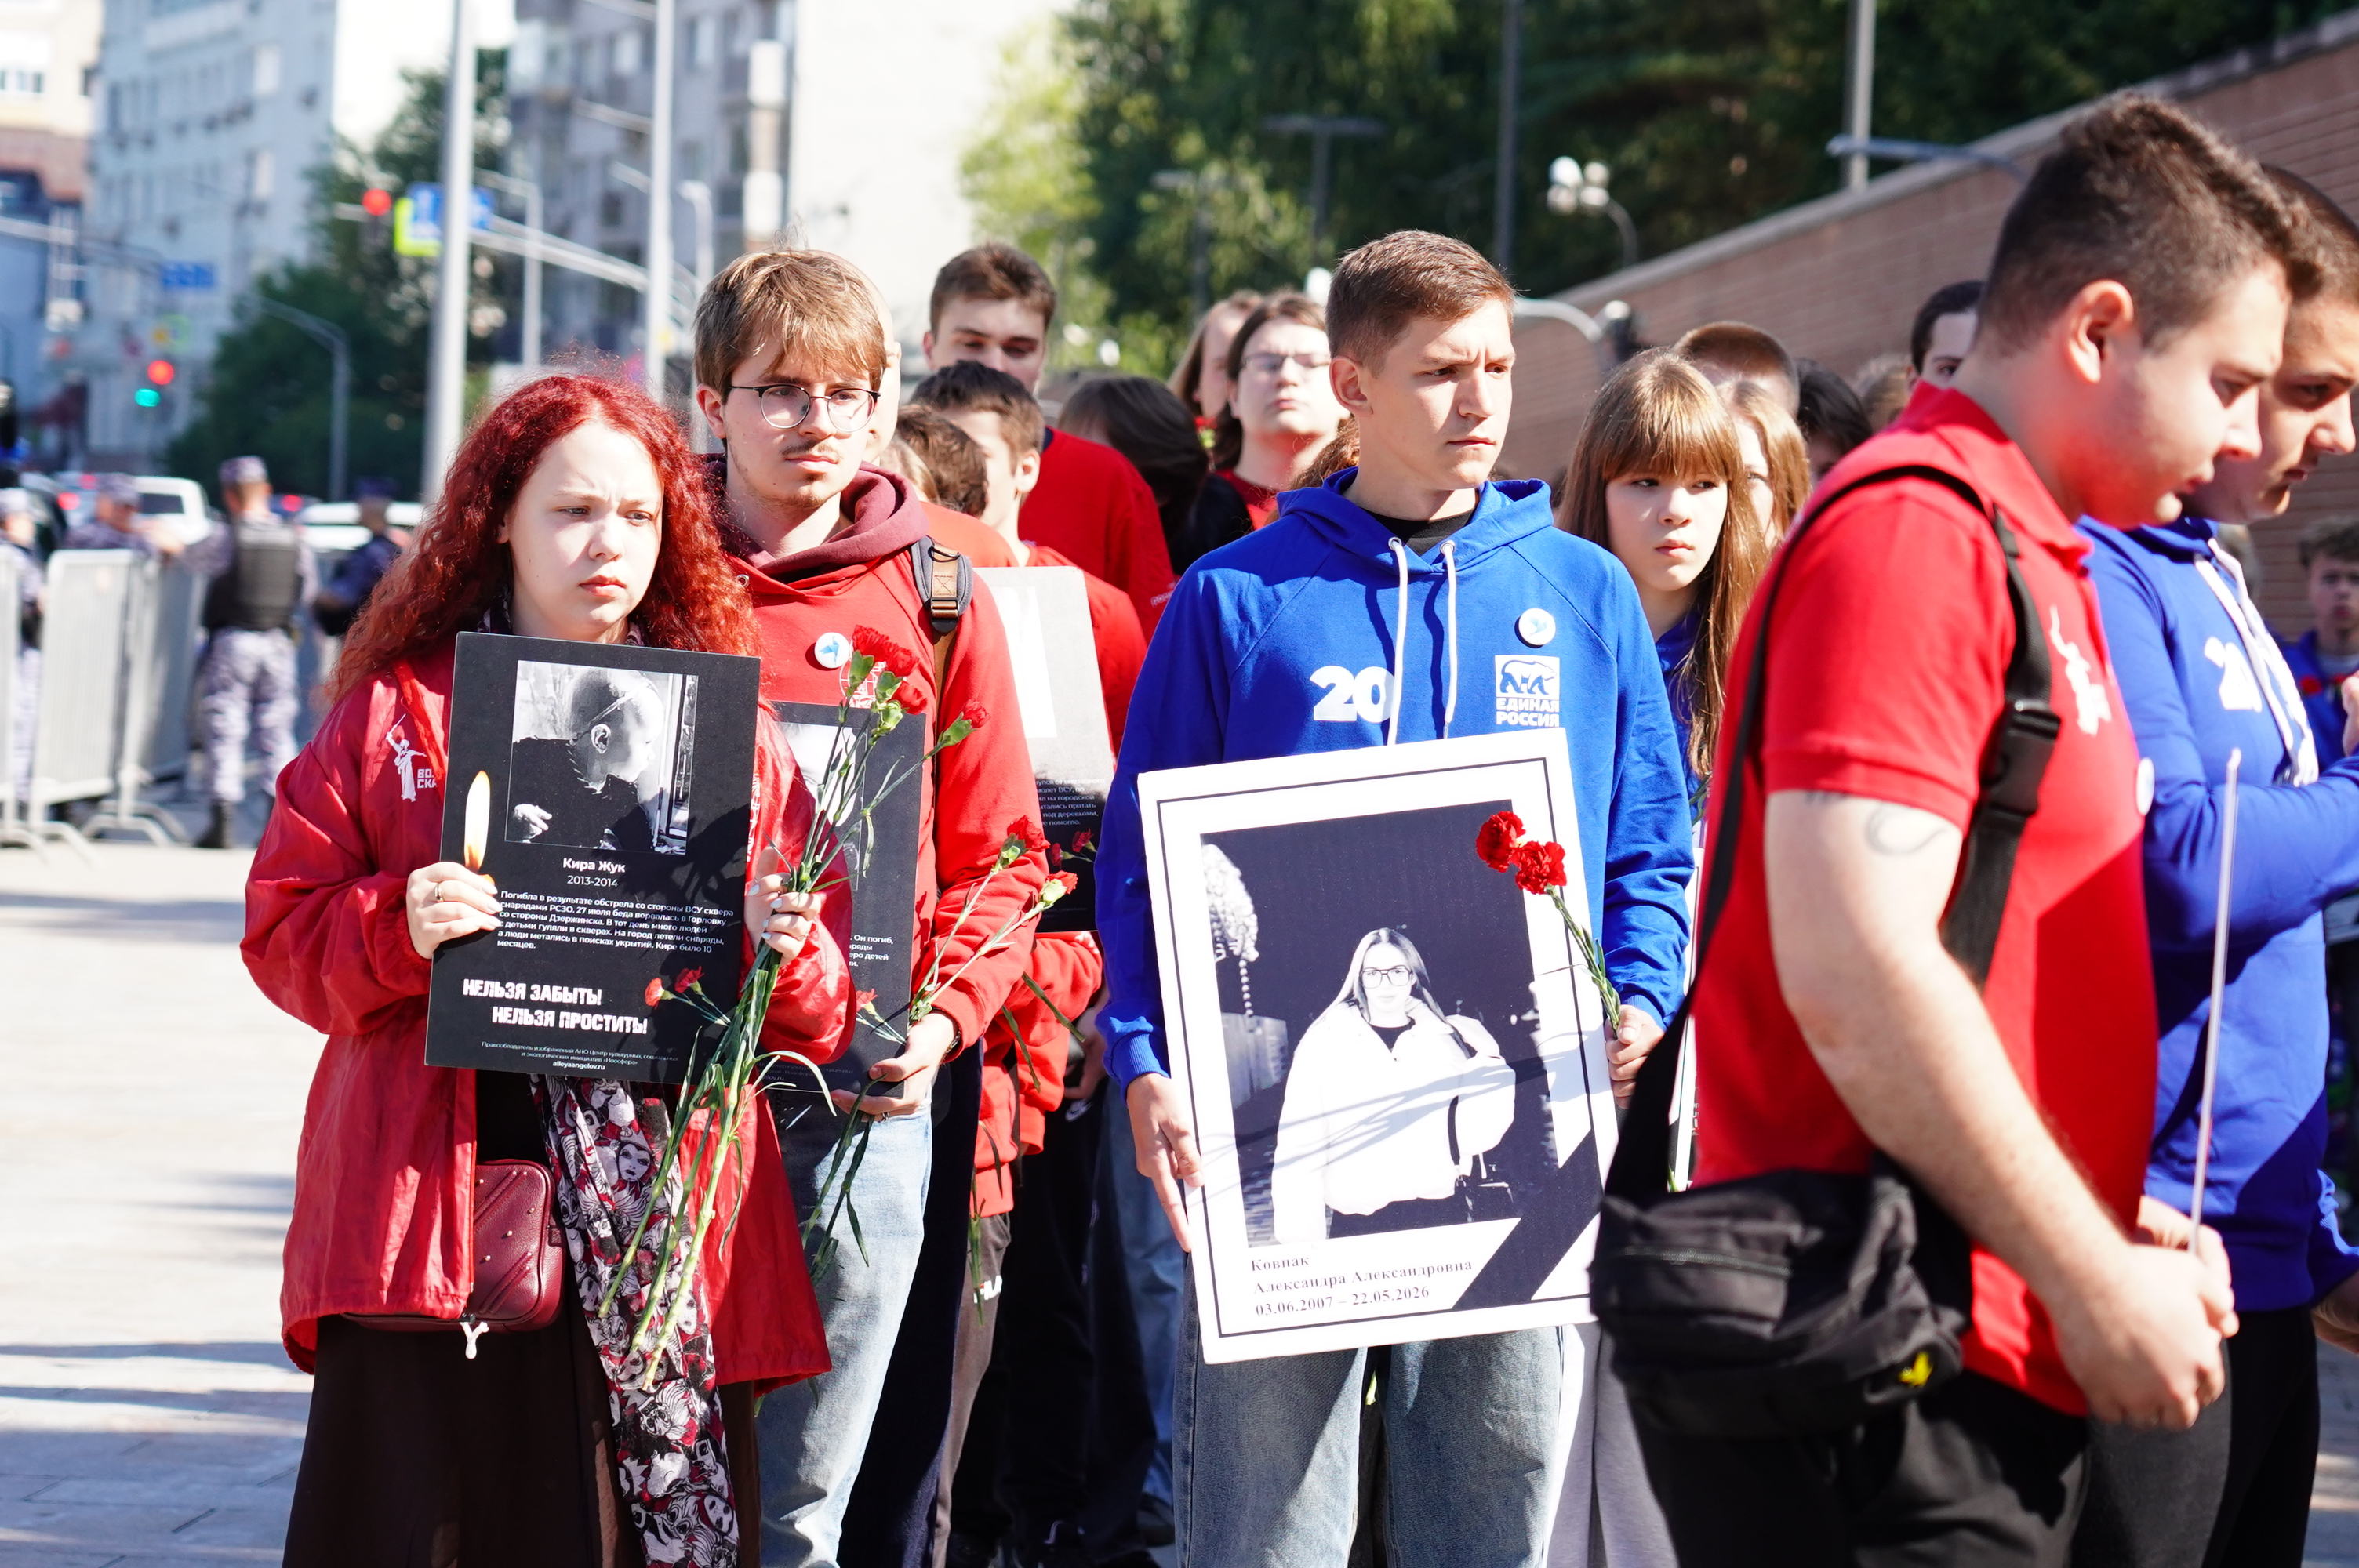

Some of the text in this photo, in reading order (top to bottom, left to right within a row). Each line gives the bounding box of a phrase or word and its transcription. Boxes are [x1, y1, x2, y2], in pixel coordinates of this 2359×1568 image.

[1309, 665, 1395, 724] 20
[1496, 697, 1560, 713] ЕДИНАЯ
[1496, 711, 1560, 727] РОССИЯ
[563, 858, 626, 874] Кира Жук
[567, 875, 618, 887] 2013-2014
[500, 891, 538, 900] Погибла
[547, 895, 593, 905] результате
[594, 898, 634, 908] обстрела
[648, 904, 683, 913] стороны
[704, 908, 734, 916] сквера
[500, 902, 547, 911] снарядами
[612, 909, 634, 919] беда
[635, 913, 679, 922] ворвалась
[688, 916, 726, 927] Горловку
[511, 913, 547, 921] стороны
[549, 914, 604, 925] Дзержинска.
[629, 921, 649, 930] день
[505, 931, 529, 939] люди
[530, 933, 571, 942] метались
[615, 940, 654, 949] укрытий.
[538, 924, 568, 933] гуляли
[576, 927, 612, 936] скверах.
[627, 931, 652, 940] город
[685, 936, 725, 946] снаряды,
[463, 978, 602, 1005] НЕЛЬЗЯ ЗАБЫТЬ!
[492, 1006, 648, 1034] НЕЛЬЗЯ ПРОСТИТЬ!
[553, 1061, 605, 1071] alleyaangelov.ru
[1251, 1257, 1310, 1272] Ковпак
[1254, 1261, 1473, 1294] Александра Александровна
[1256, 1297, 1332, 1316] 03.06.2007
[1352, 1286, 1429, 1305] 22.05.2026
